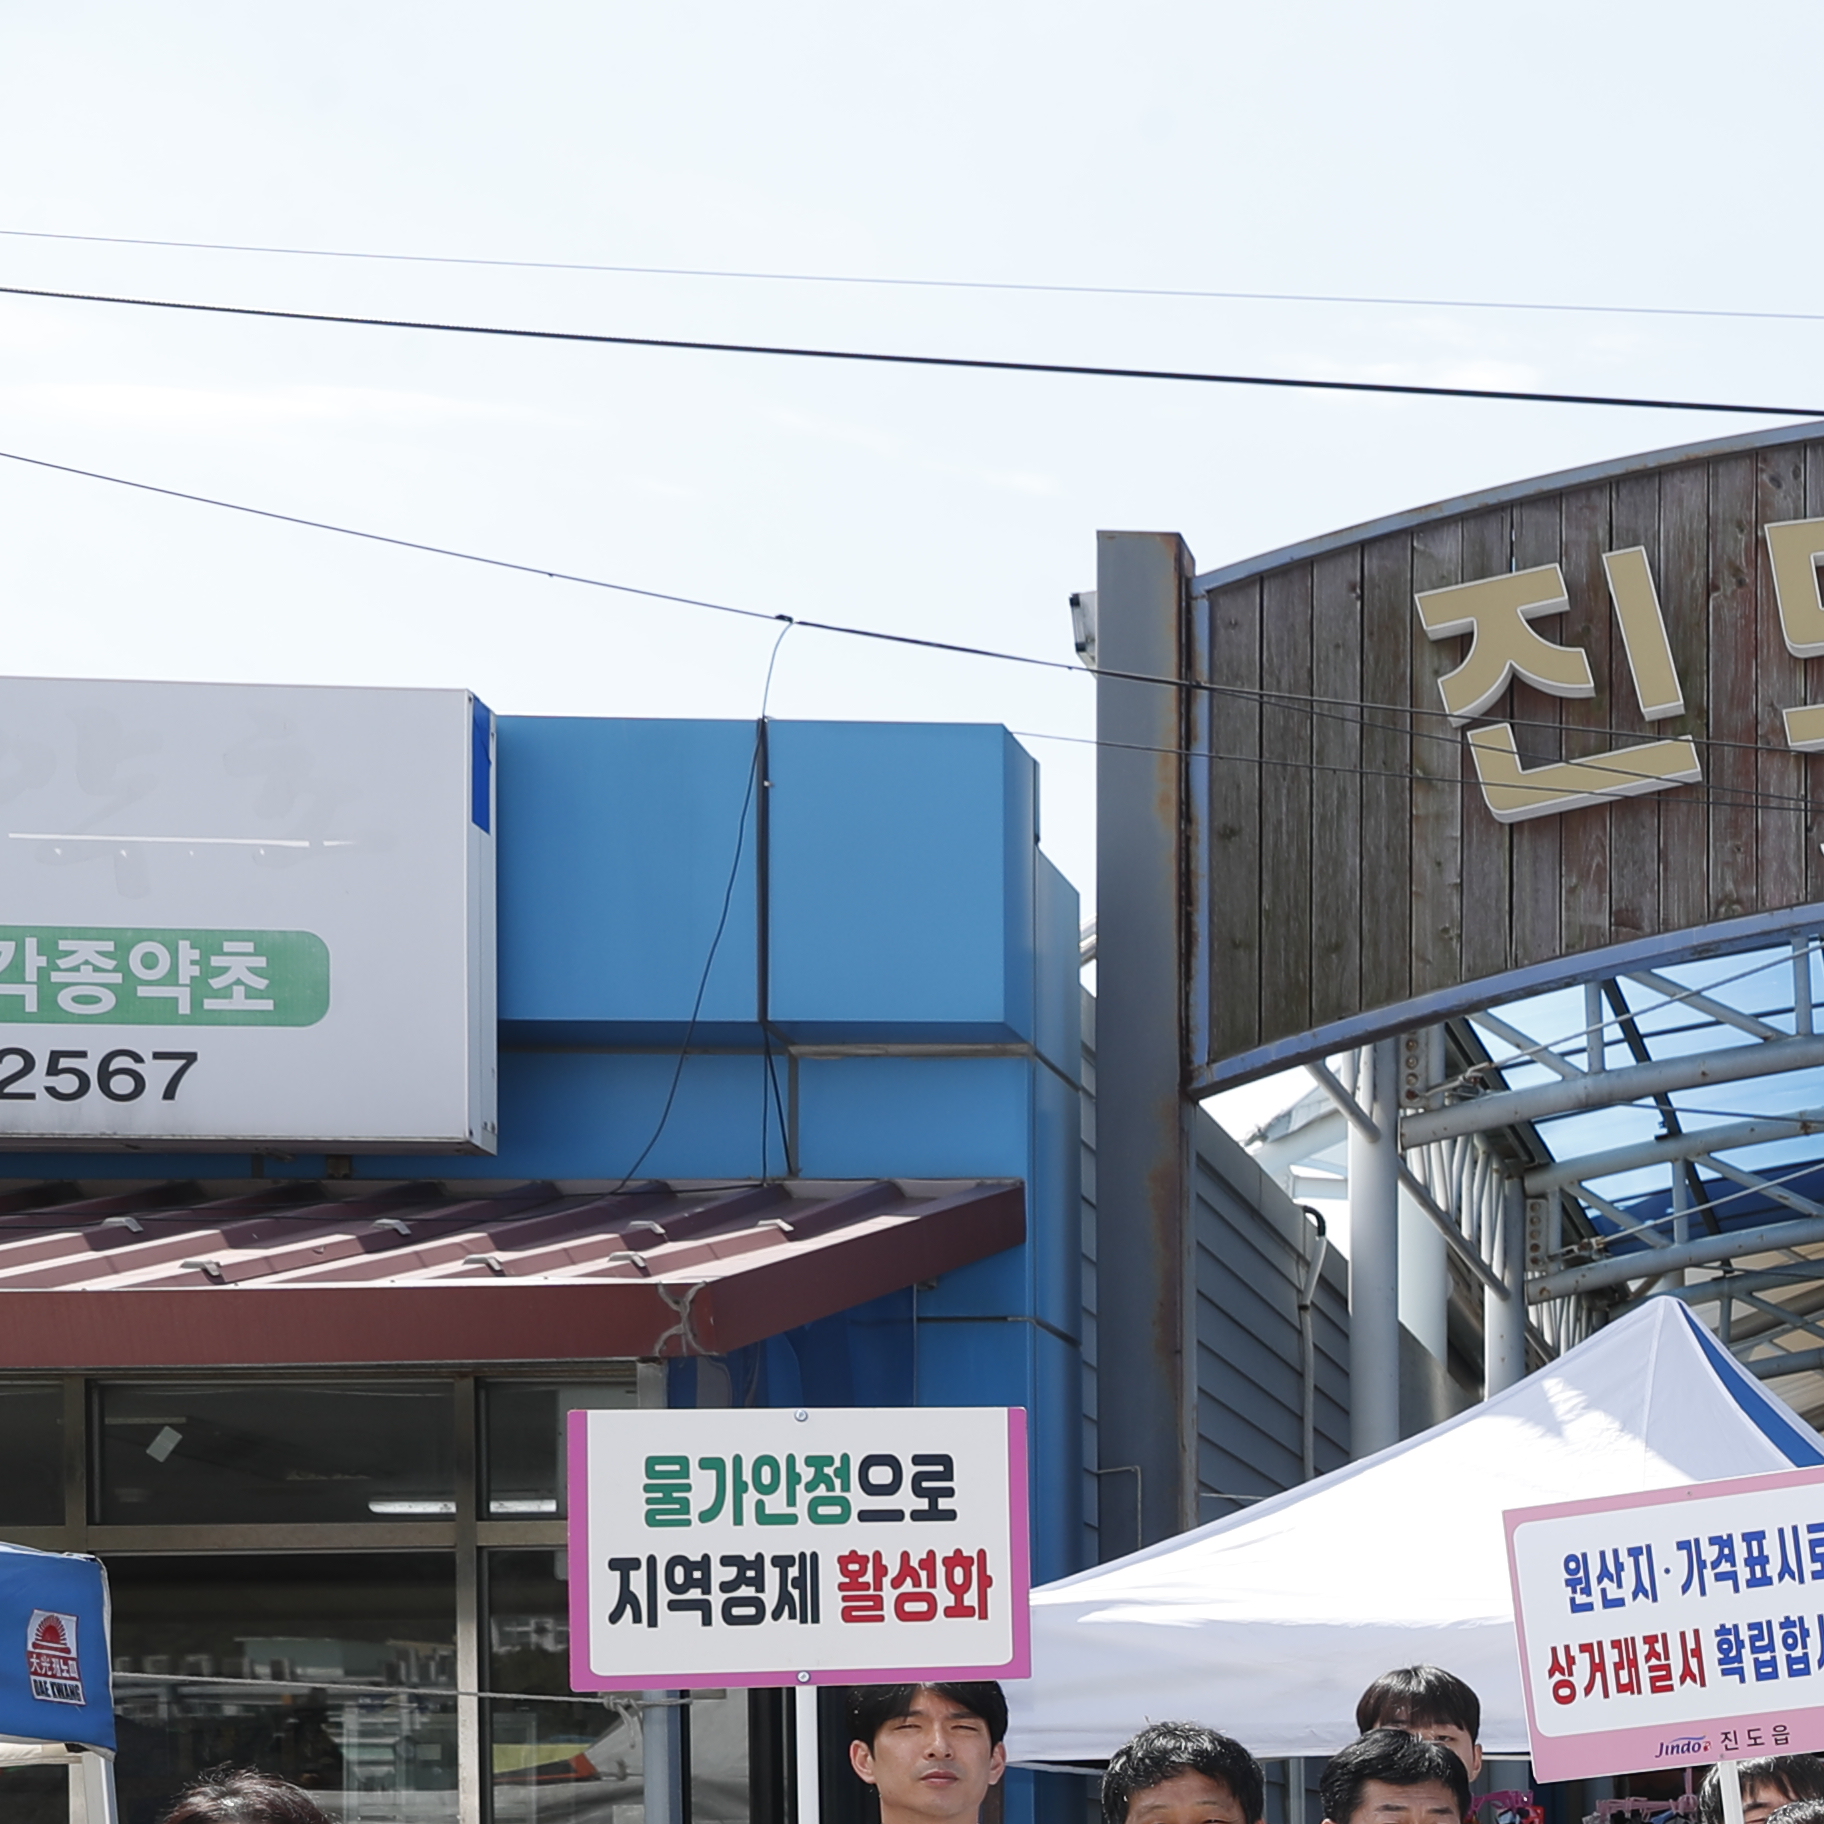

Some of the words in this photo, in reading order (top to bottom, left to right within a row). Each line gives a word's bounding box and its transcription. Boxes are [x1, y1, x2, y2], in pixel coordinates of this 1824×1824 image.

[0, 936, 274, 1015] 각종약초
[0, 1047, 199, 1102] 2567
[642, 1453, 957, 1529] 물가안정으로
[606, 1551, 821, 1629] 지역경제
[835, 1548, 995, 1625] 활성화
[1546, 1626, 1706, 1705] 상거래질서
[1655, 1740, 1701, 1759] Jindo
[1720, 1724, 1791, 1752] 진도읍
